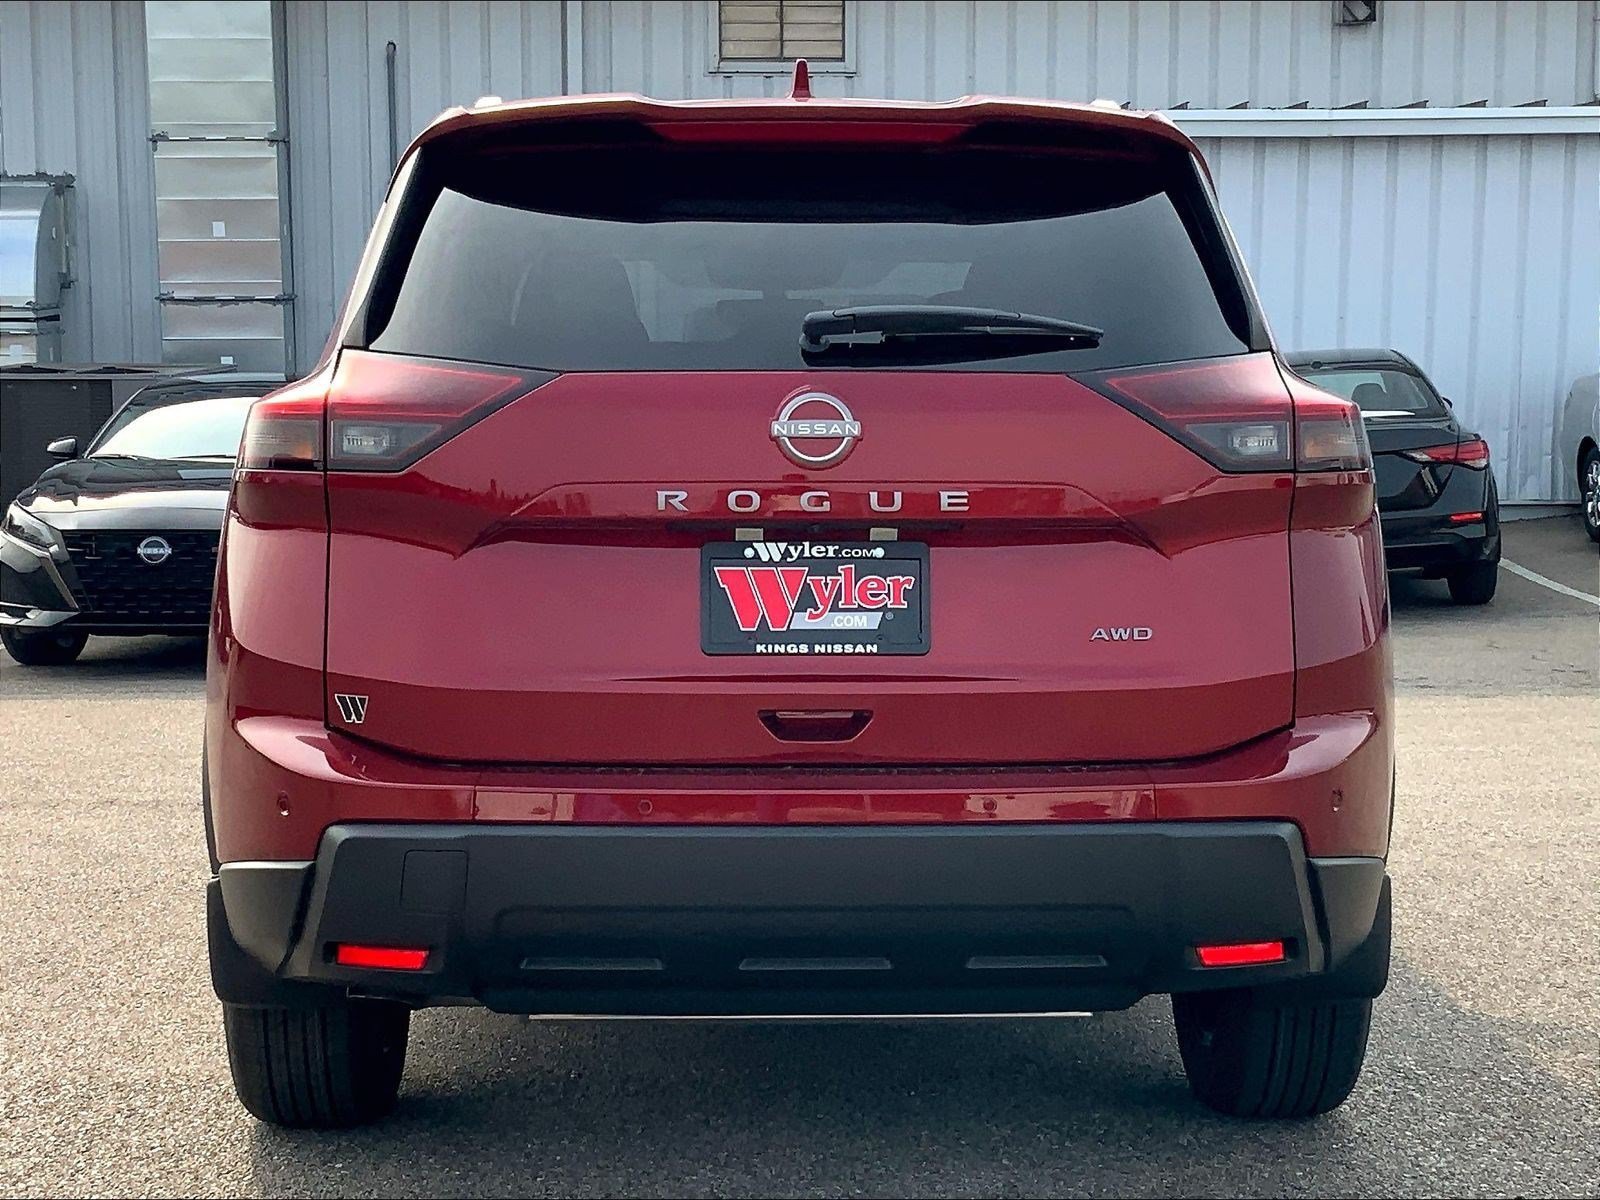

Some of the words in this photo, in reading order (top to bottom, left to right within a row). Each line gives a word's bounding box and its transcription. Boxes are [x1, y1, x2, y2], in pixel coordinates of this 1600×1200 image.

[773, 422, 859, 436] NISSAN
[656, 490, 970, 512] ROGUE
[714, 564, 915, 631] Wyler
[1091, 627, 1153, 641] AWD
[756, 643, 809, 654] KINGS
[814, 643, 878, 654] NISSAN
